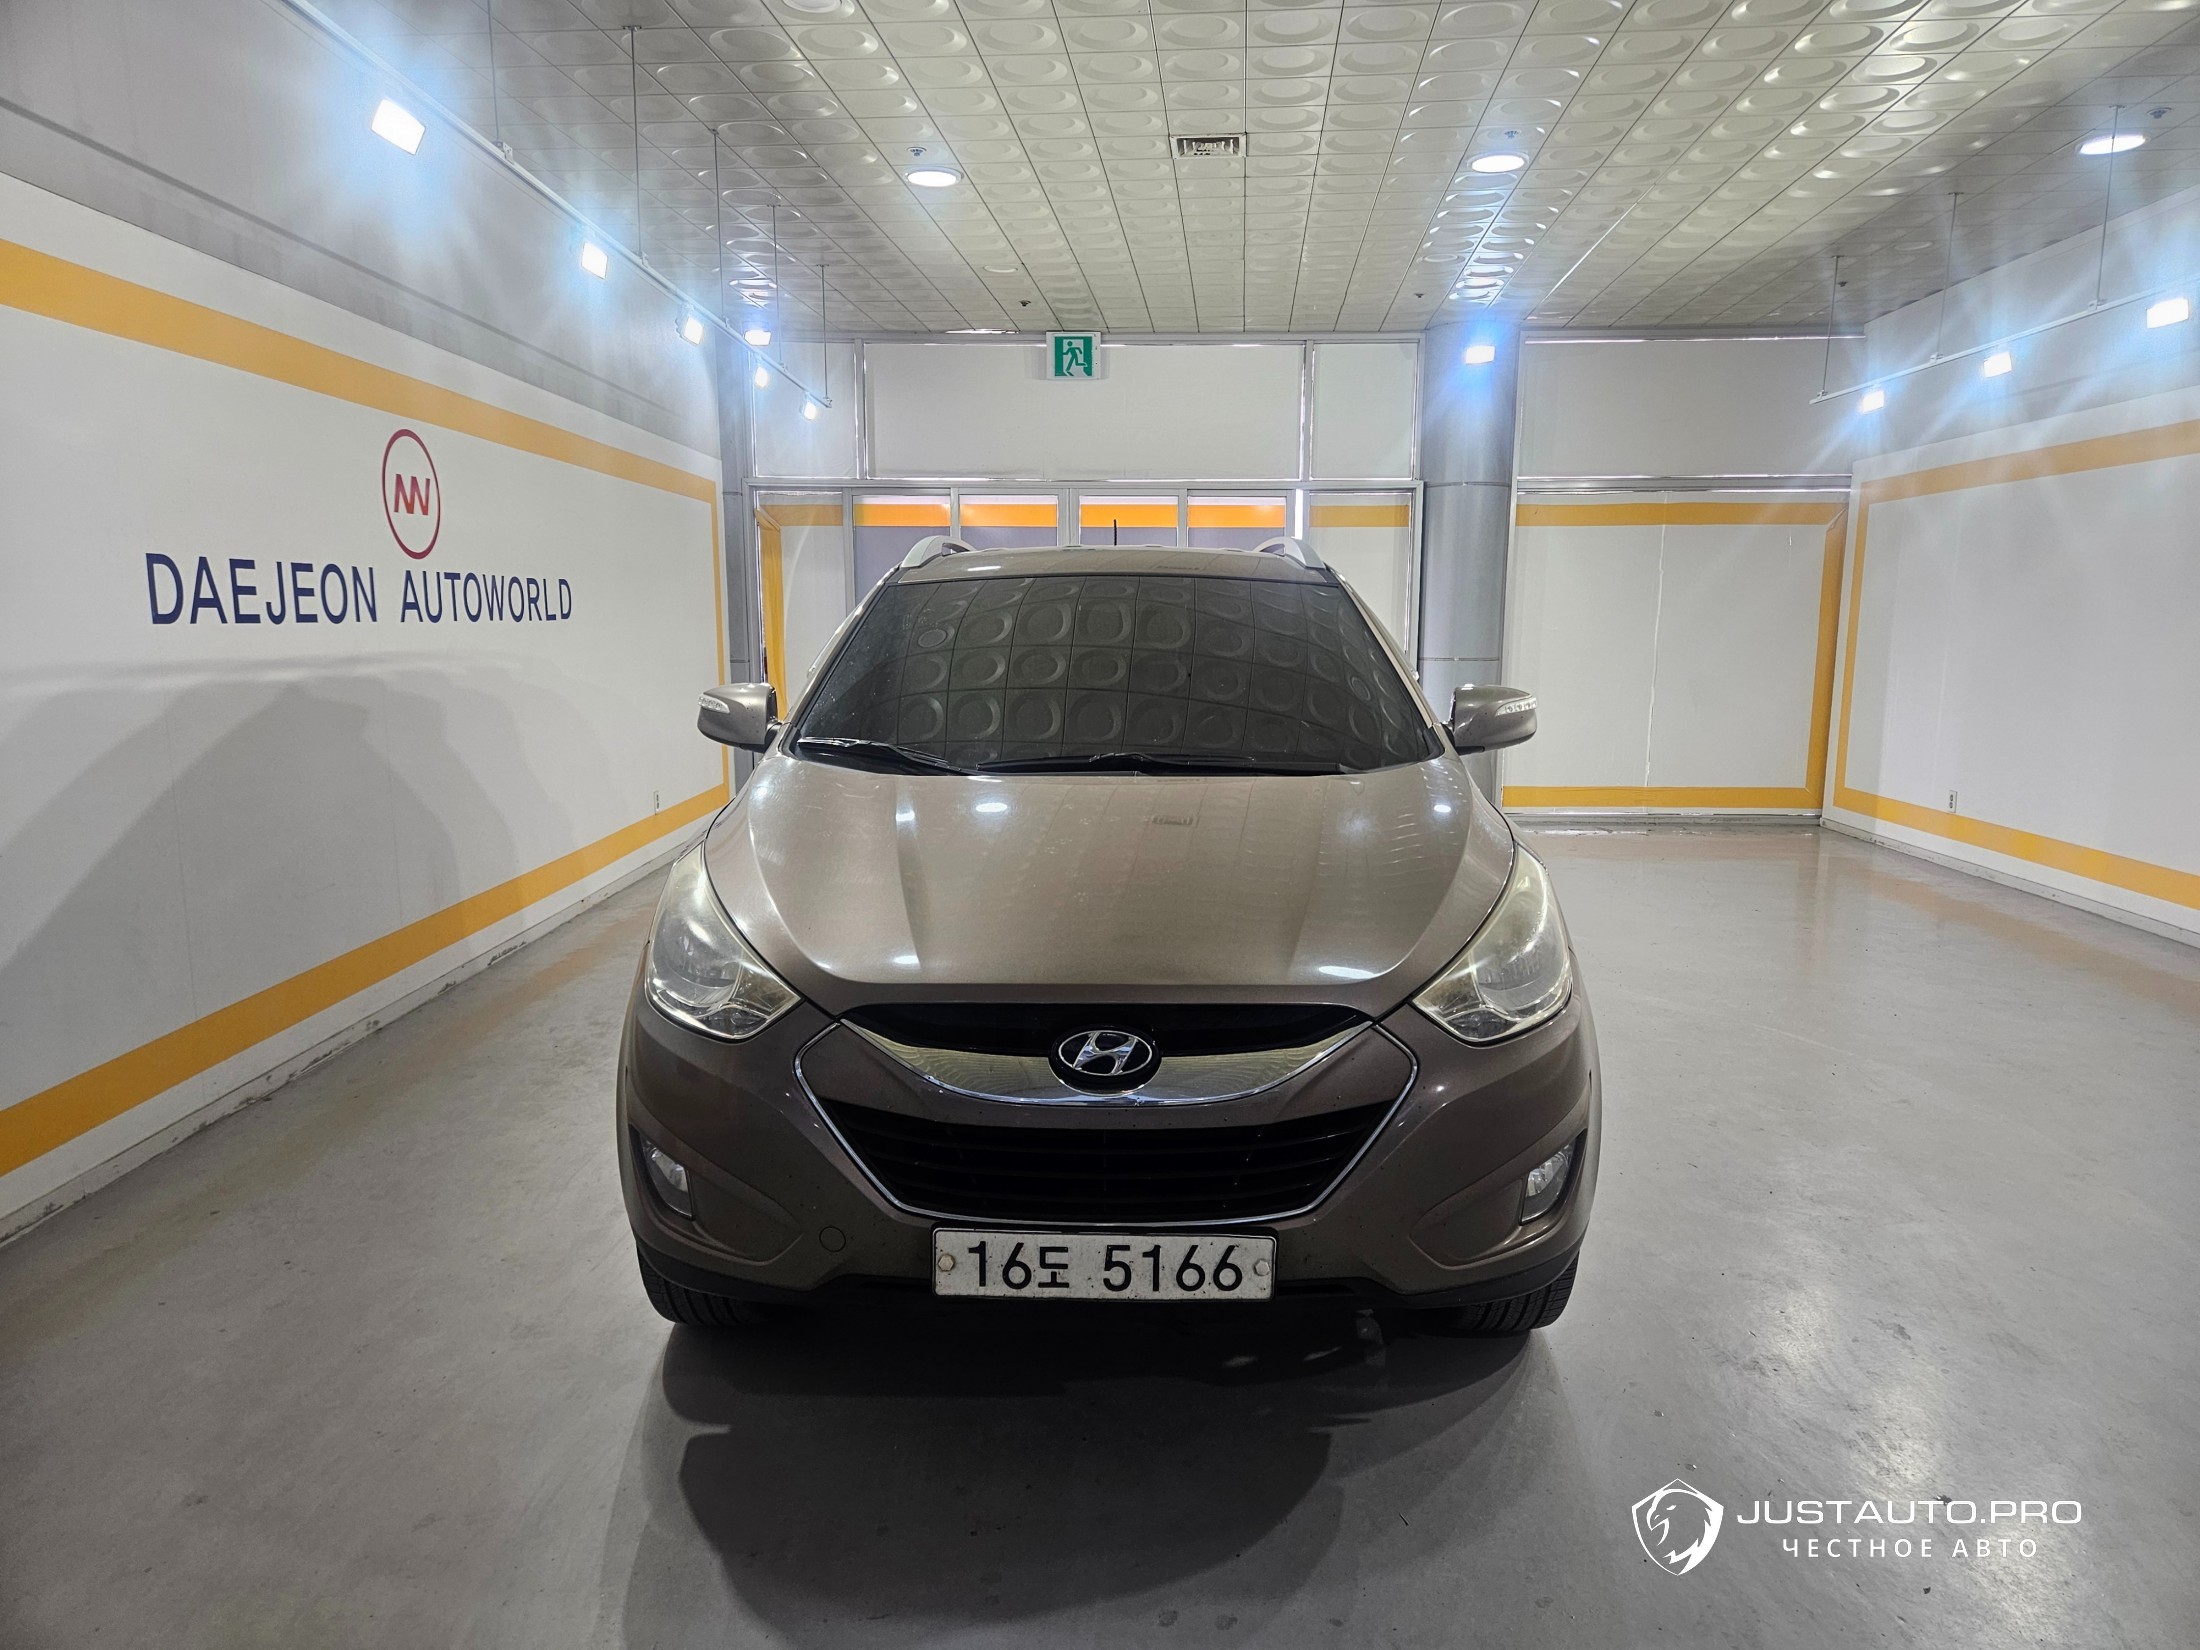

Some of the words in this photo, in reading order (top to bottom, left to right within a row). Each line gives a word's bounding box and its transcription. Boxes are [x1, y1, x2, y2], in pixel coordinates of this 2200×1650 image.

[145, 552, 378, 625] DAEJEON
[400, 569, 572, 624] AUTOWORLD
[967, 1240, 1071, 1290] 16도
[1102, 1244, 1243, 1293] 5166
